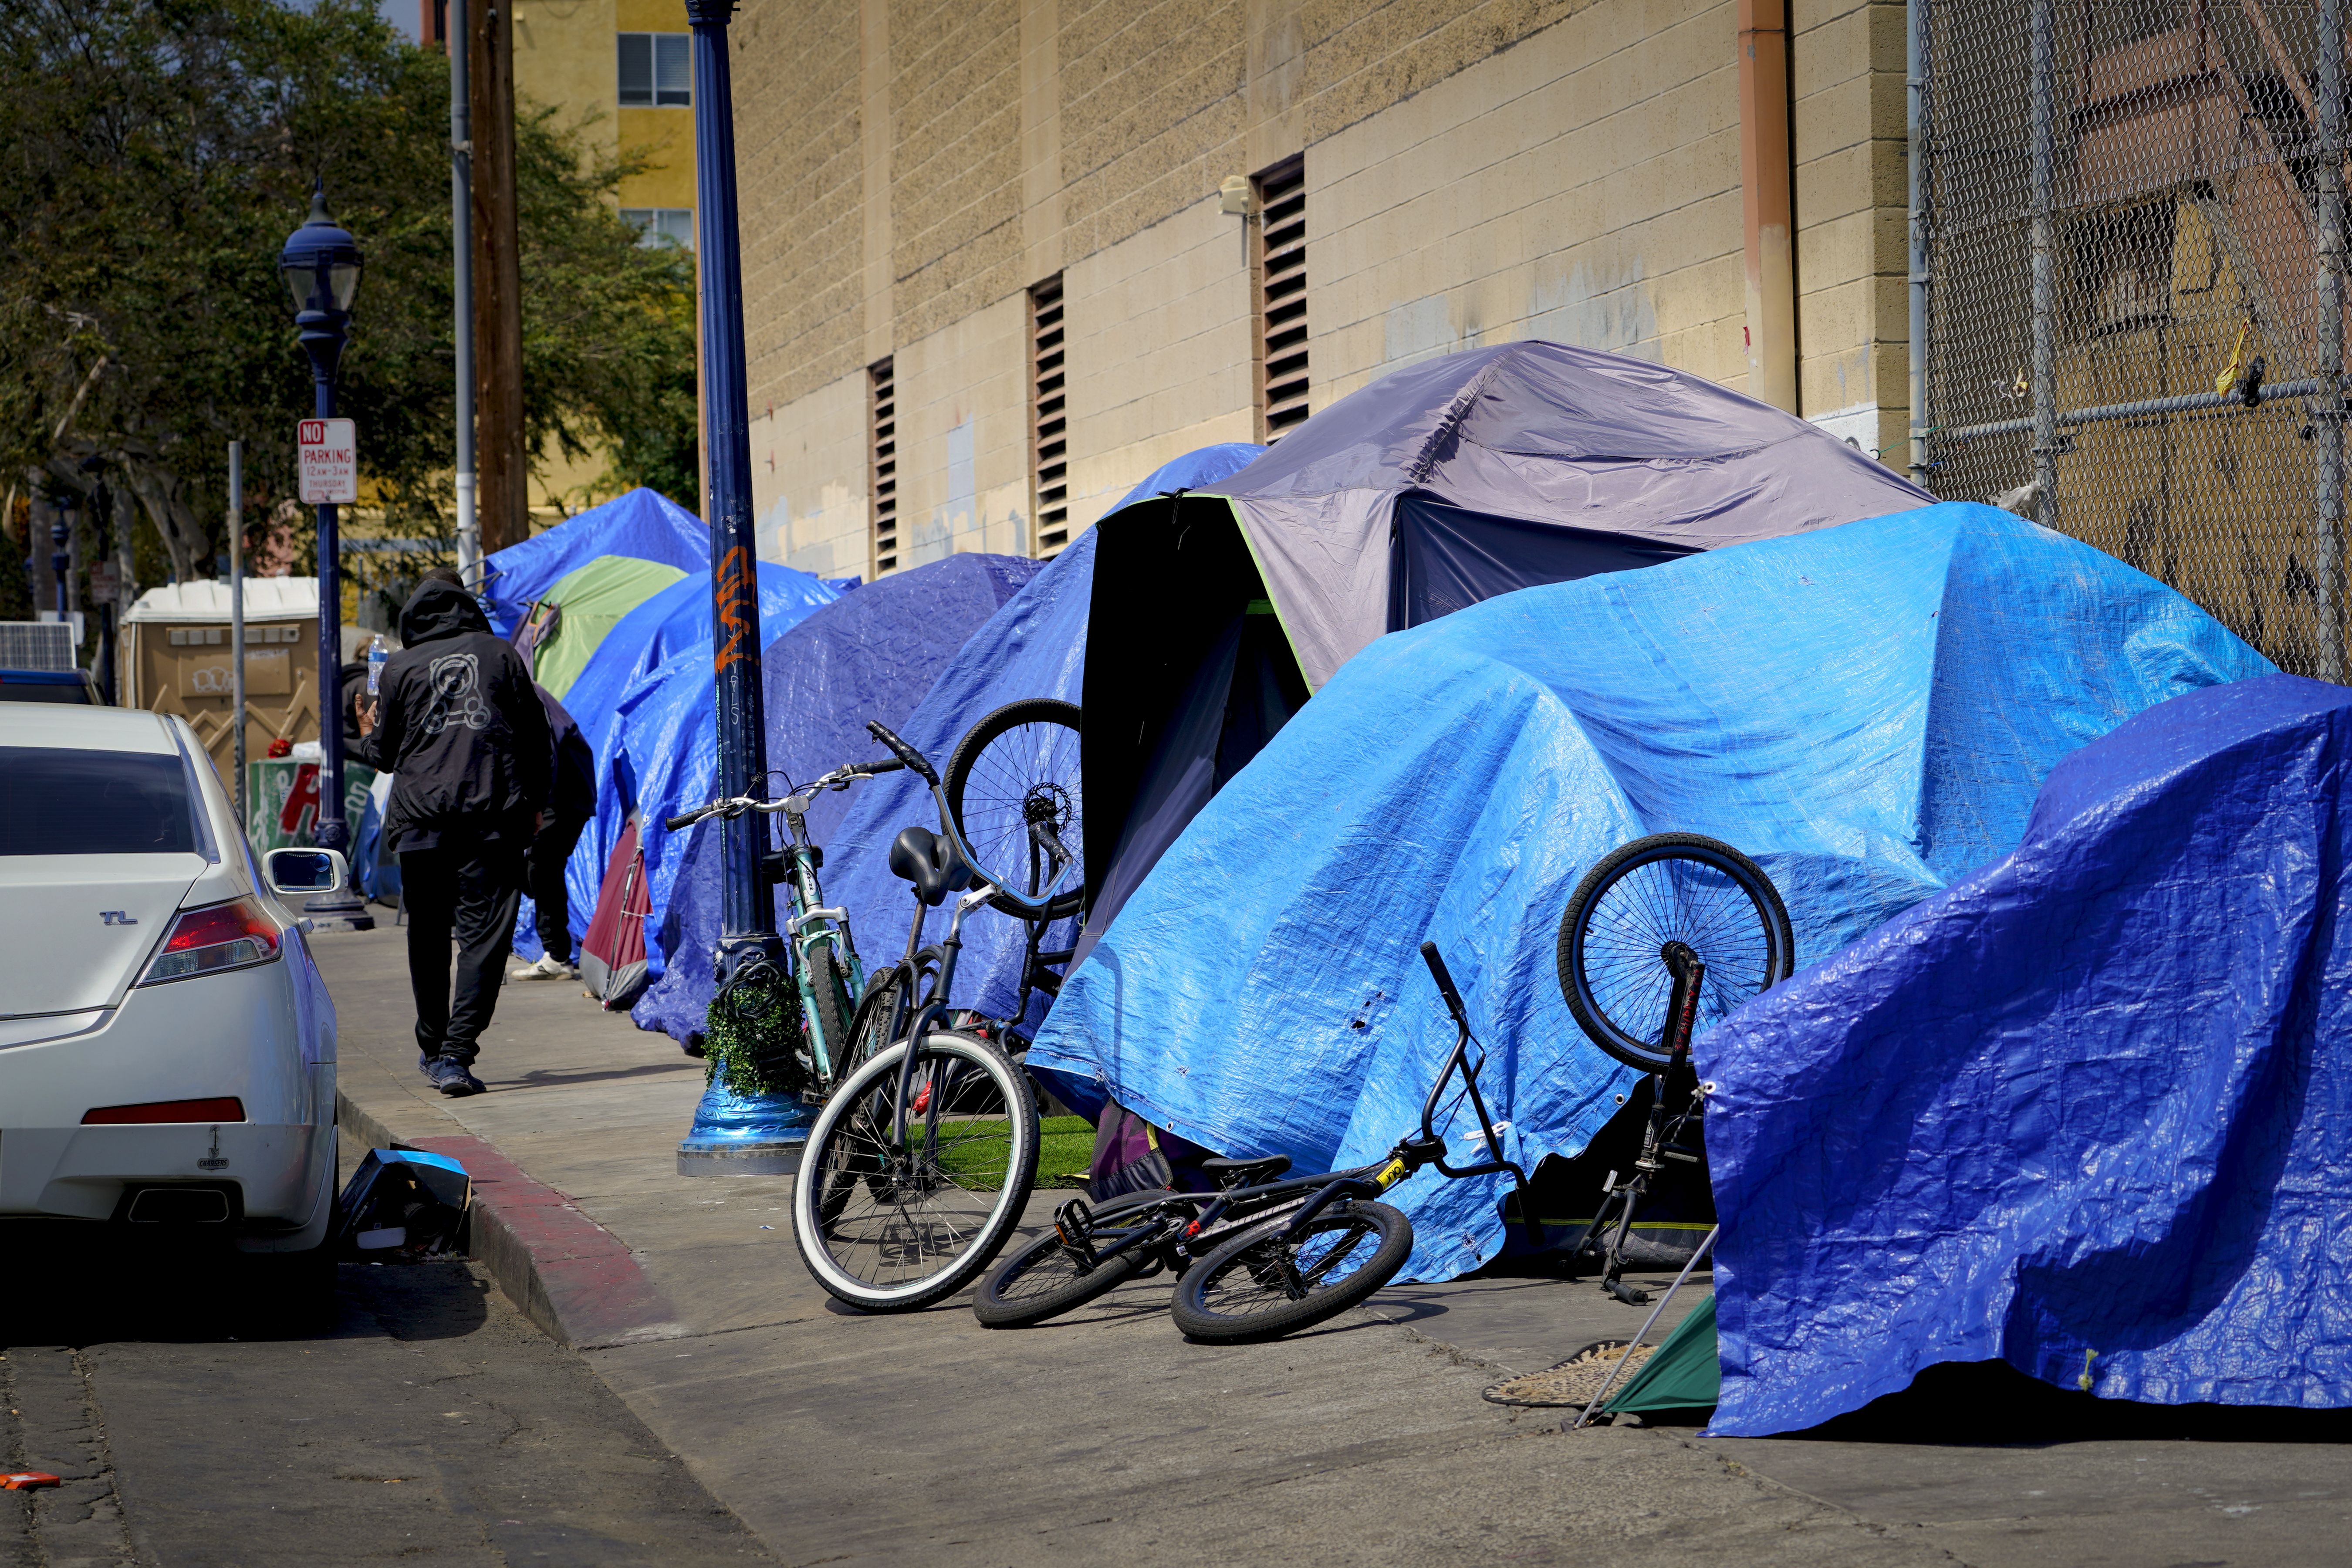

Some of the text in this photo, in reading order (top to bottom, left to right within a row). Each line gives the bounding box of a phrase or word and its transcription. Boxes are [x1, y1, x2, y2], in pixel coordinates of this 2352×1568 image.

[303, 423, 321, 442] NO
[304, 449, 351, 464] PARKING
[99, 911, 138, 923] TL
[1024, 953, 1033, 980] CRUISER
[809, 1017, 818, 1040] SUNTOUR
